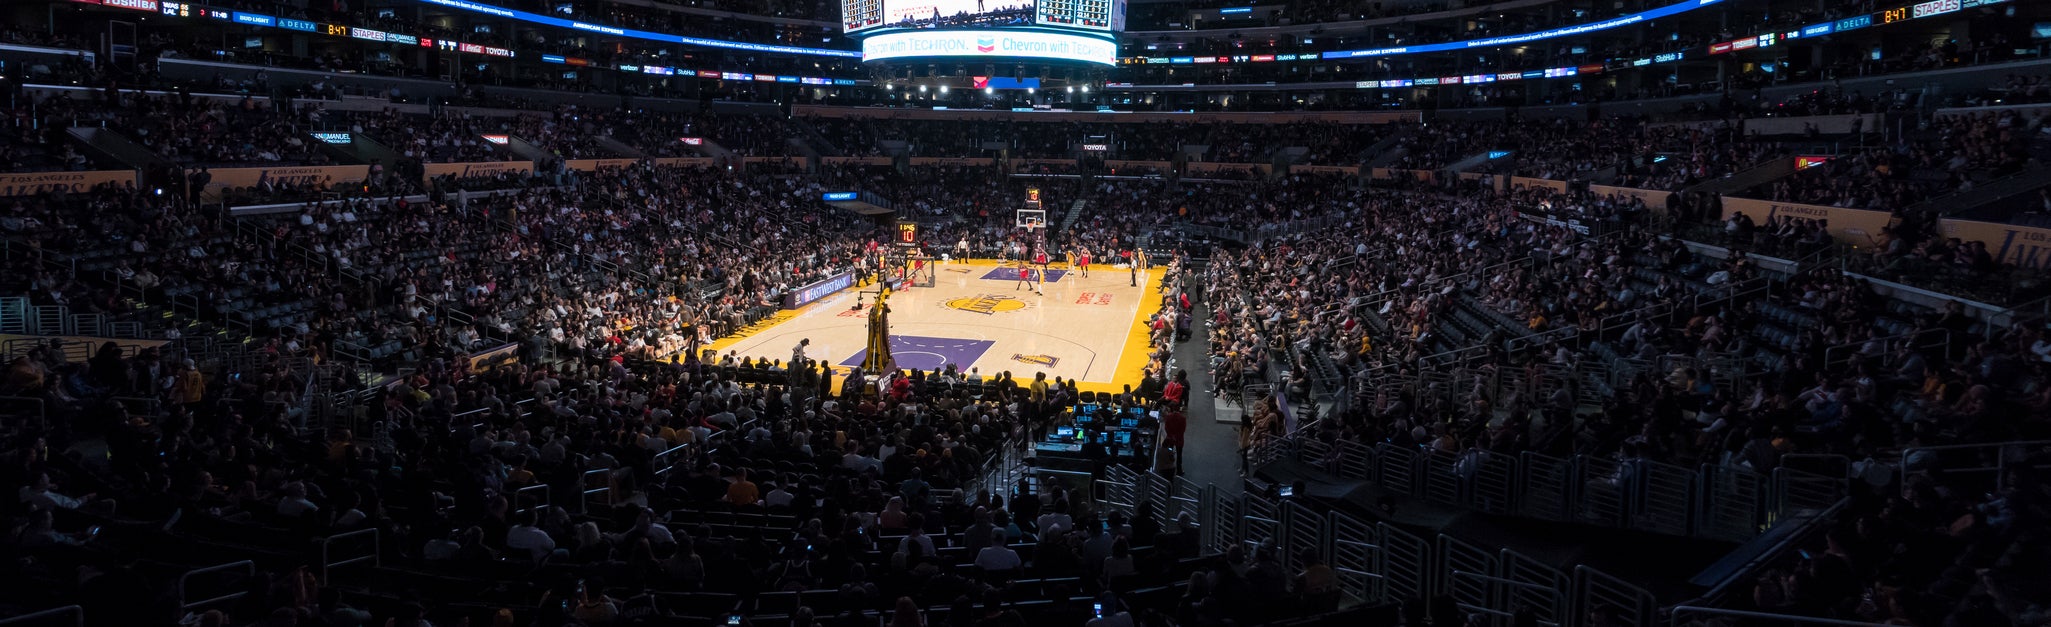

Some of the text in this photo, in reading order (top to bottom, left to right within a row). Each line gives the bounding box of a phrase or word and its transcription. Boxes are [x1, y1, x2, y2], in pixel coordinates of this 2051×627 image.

[1915, 0, 1959, 16] STAPLES
[253, 16, 270, 24] LIGHT
[1884, 8, 1905, 23] 8:47
[288, 21, 315, 30] DELTA
[573, 22, 623, 34] AMERICAN EXPRESS
[1844, 17, 1870, 29] DELTA
[328, 24, 346, 35] 8:47
[353, 28, 384, 40] STAPLES
[890, 40, 905, 52] with
[1002, 38, 1047, 51] Chevron
[1049, 39, 1069, 53] with
[1733, 38, 1757, 49] TOSHIBA
[486, 47, 509, 56] TOYOTA
[1351, 48, 1380, 56] AMERICAN
[1656, 53, 1676, 62] StubHub
[34, 174, 85, 182] ANGELES
[1795, 207, 1828, 216] ANGELES
[903, 231, 913, 242] 10
[2024, 231, 2047, 242] LOS
[835, 276, 848, 292] BANK
